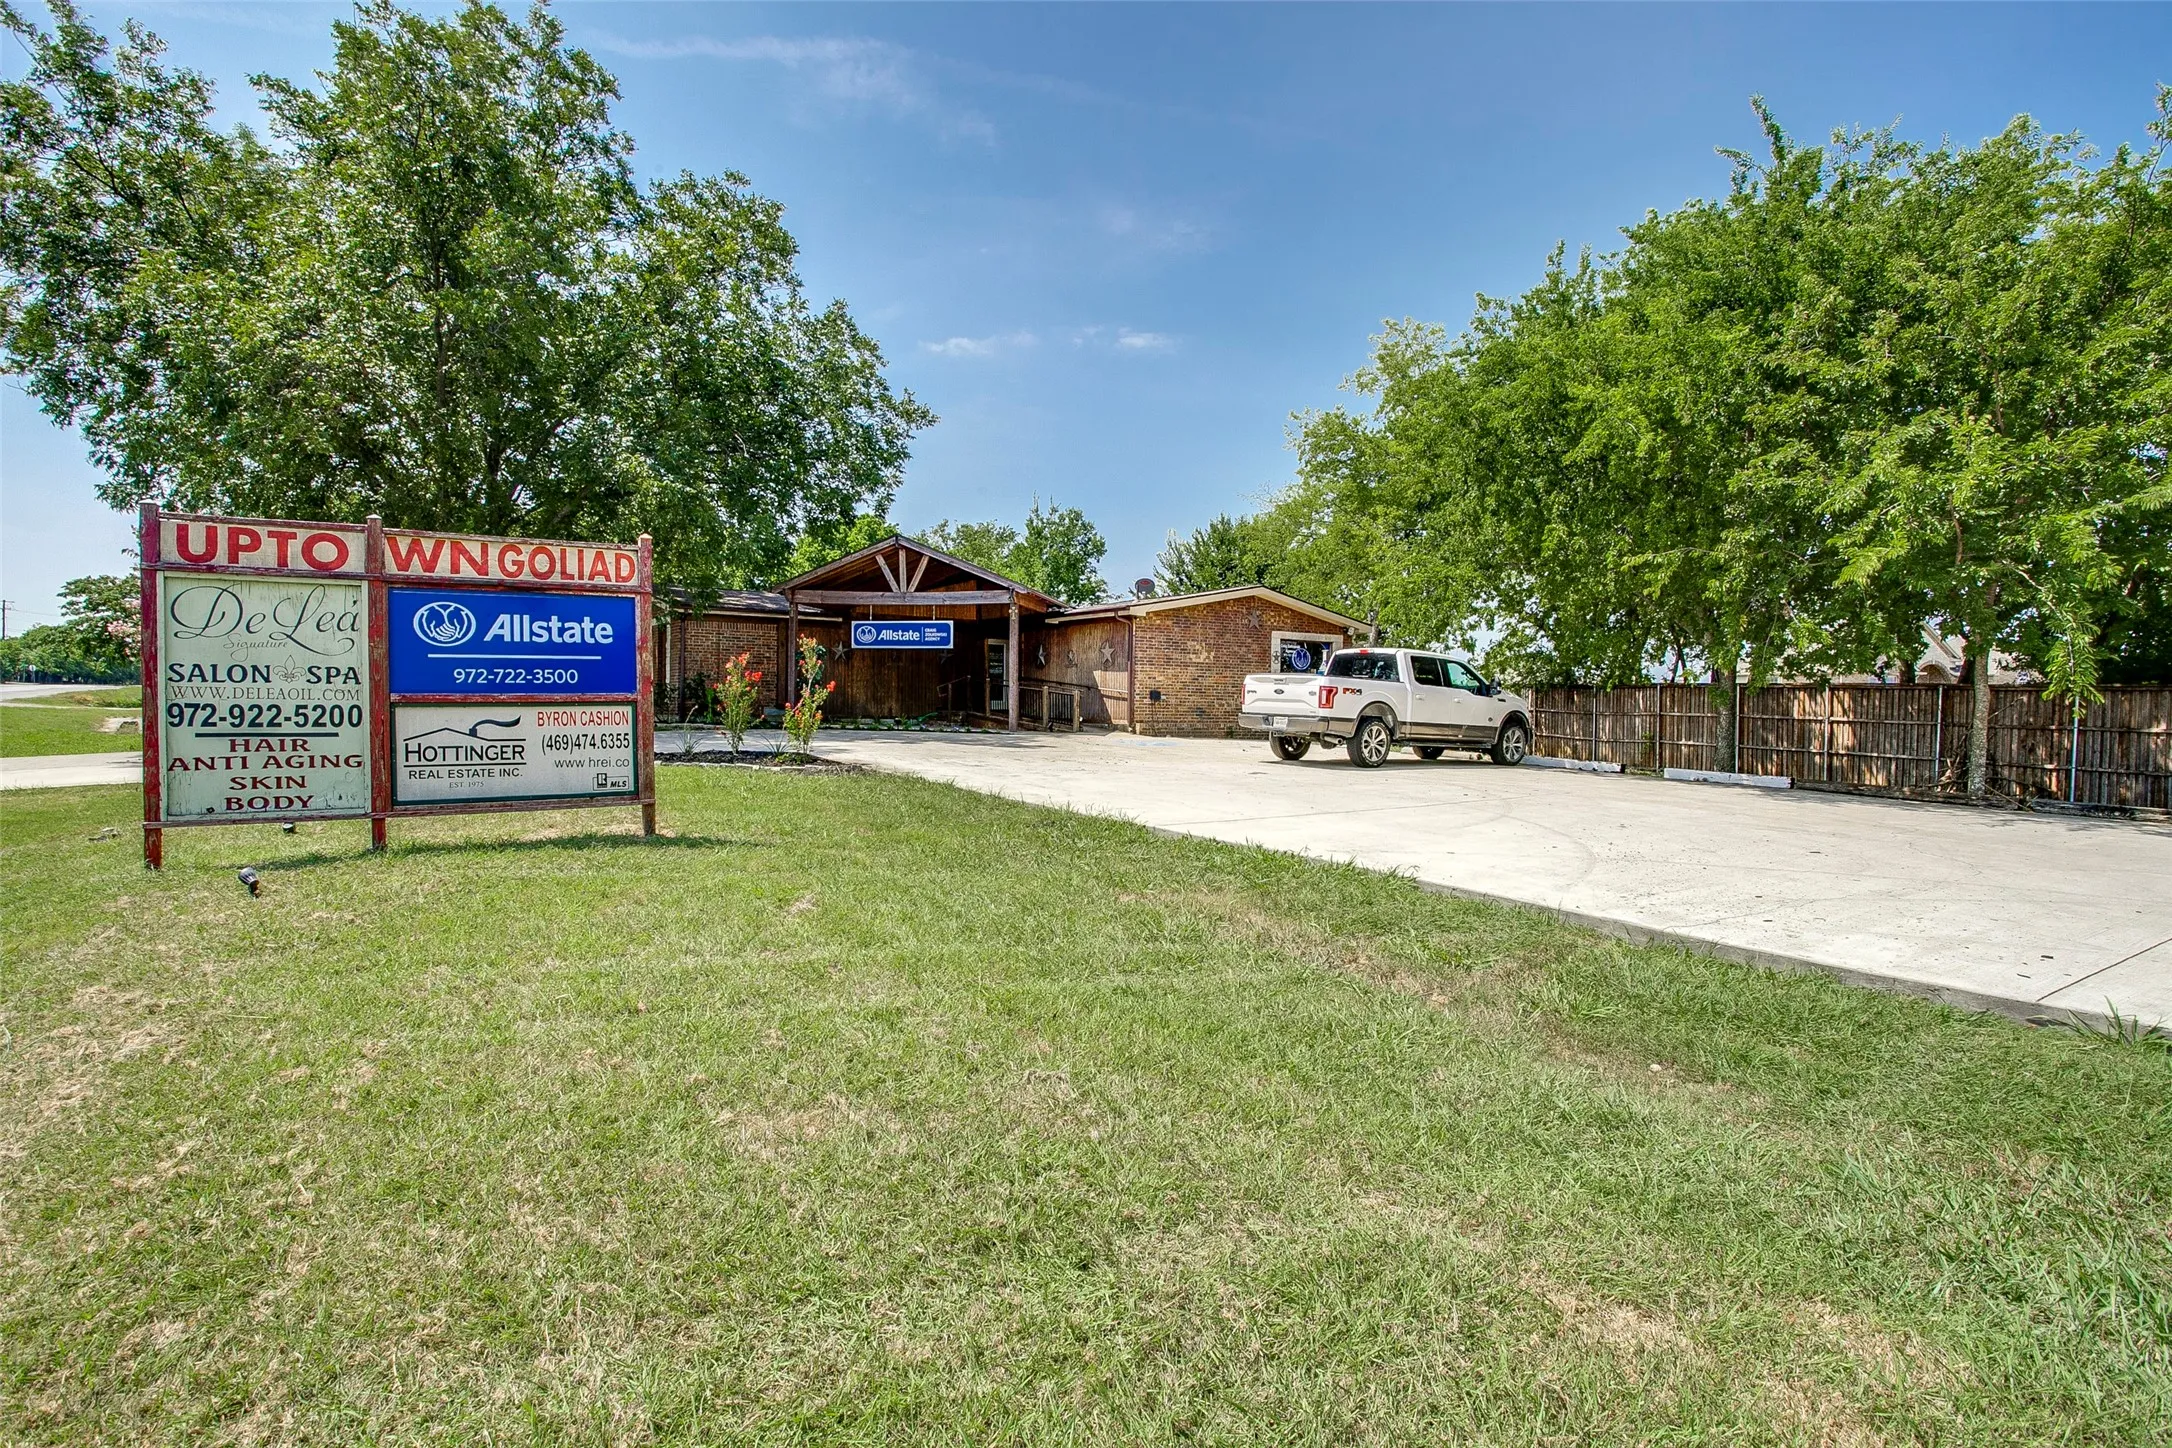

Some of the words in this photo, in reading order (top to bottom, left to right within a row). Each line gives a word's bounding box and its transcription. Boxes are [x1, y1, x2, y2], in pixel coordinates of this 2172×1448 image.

[175, 523, 350, 572] UPTO
[497, 544, 636, 583] GOLIAD
[483, 614, 614, 644] Allstate
[878, 629, 920, 641] Allstate
[222, 633, 289, 662] Signature
[167, 663, 272, 684] SALON
[306, 665, 362, 685] SPA
[453, 669, 579, 684] 972-722-3500
[170, 685, 361, 701] WWW.DELEAOIL.COM
[1342, 687, 1363, 696] FX4
[167, 703, 363, 728] 972-922-5200
[537, 711, 577, 727] BYRON
[580, 710, 629, 726] CASHION
[228, 739, 311, 753] HAIR
[168, 755, 250, 772] ANTI
[262, 754, 364, 769] AGING
[408, 769, 444, 780] REAL
[447, 768, 496, 779] ESTATE
[499, 767, 524, 777] INC.
[229, 775, 307, 791] SKIN
[609, 780, 628, 788] MLS
[225, 795, 314, 811] BODY
